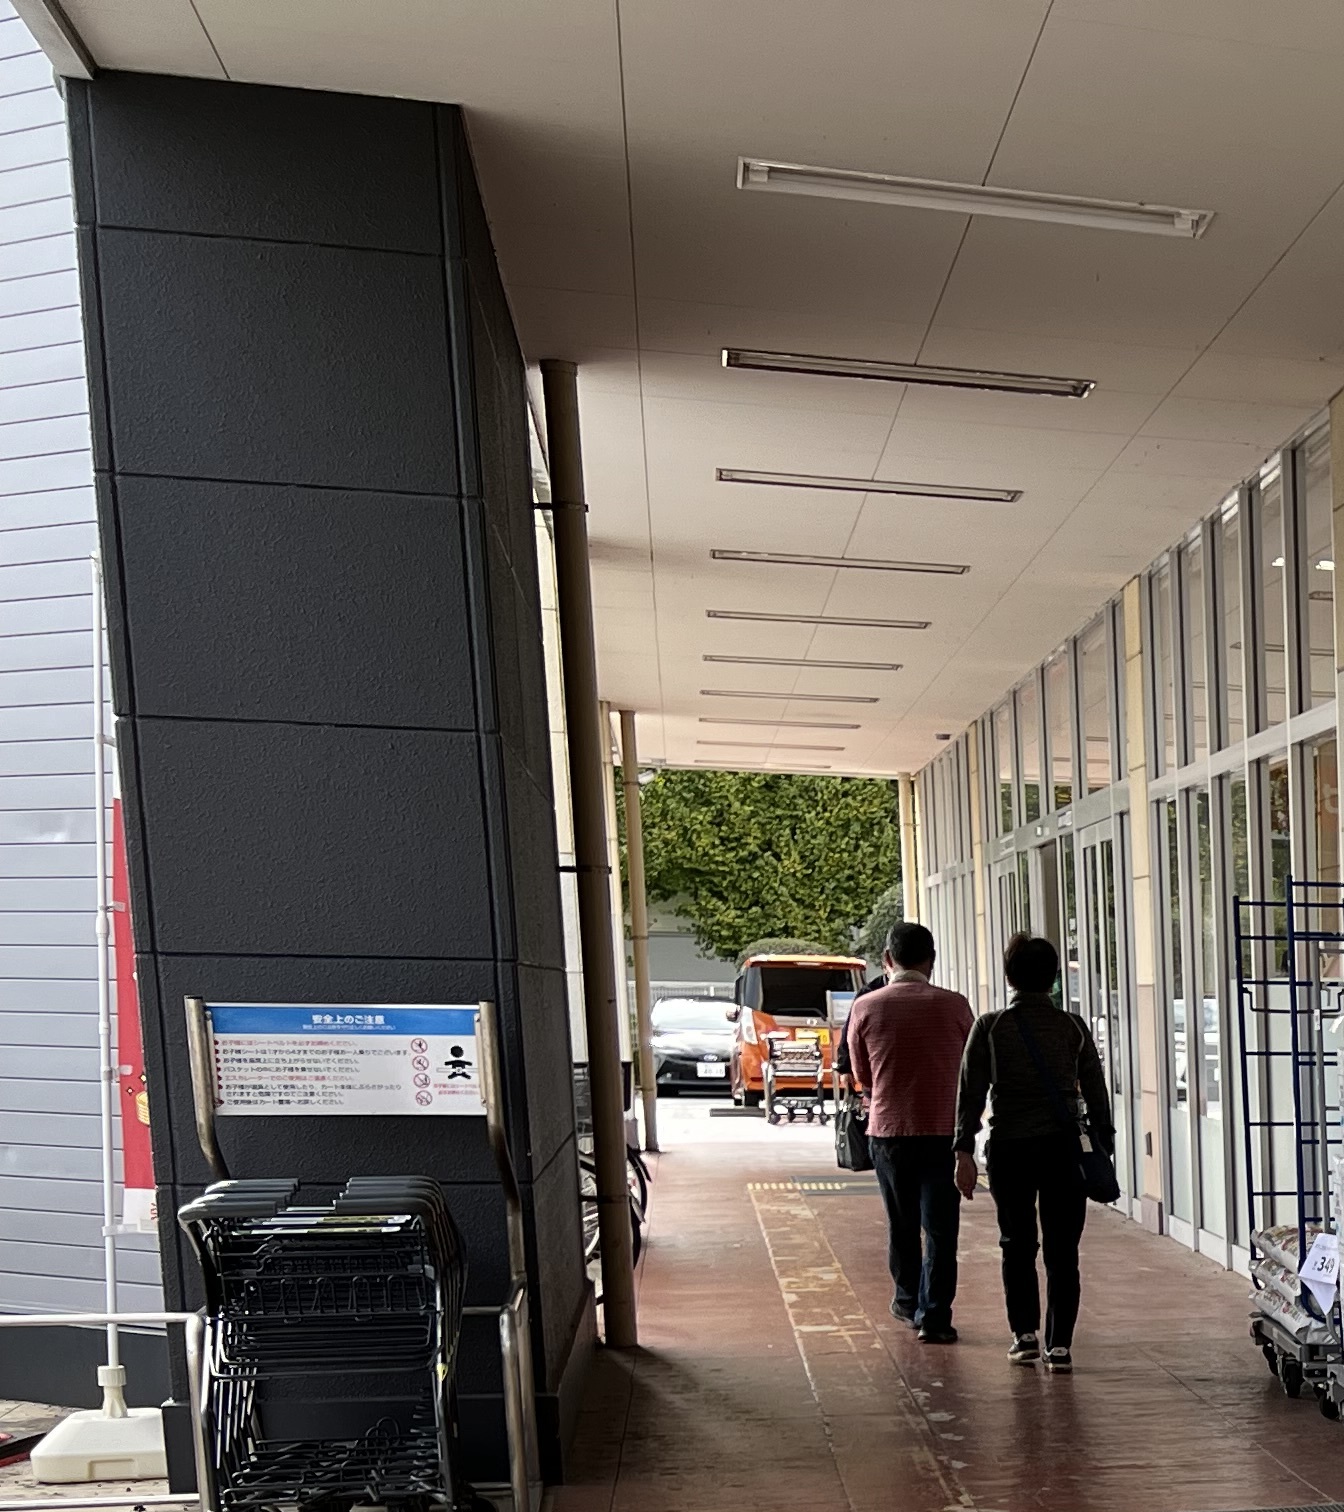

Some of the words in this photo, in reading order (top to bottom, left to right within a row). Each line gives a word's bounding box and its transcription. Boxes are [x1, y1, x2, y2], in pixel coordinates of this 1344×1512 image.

[311, 1014, 385, 1025] 安全上のご注意
